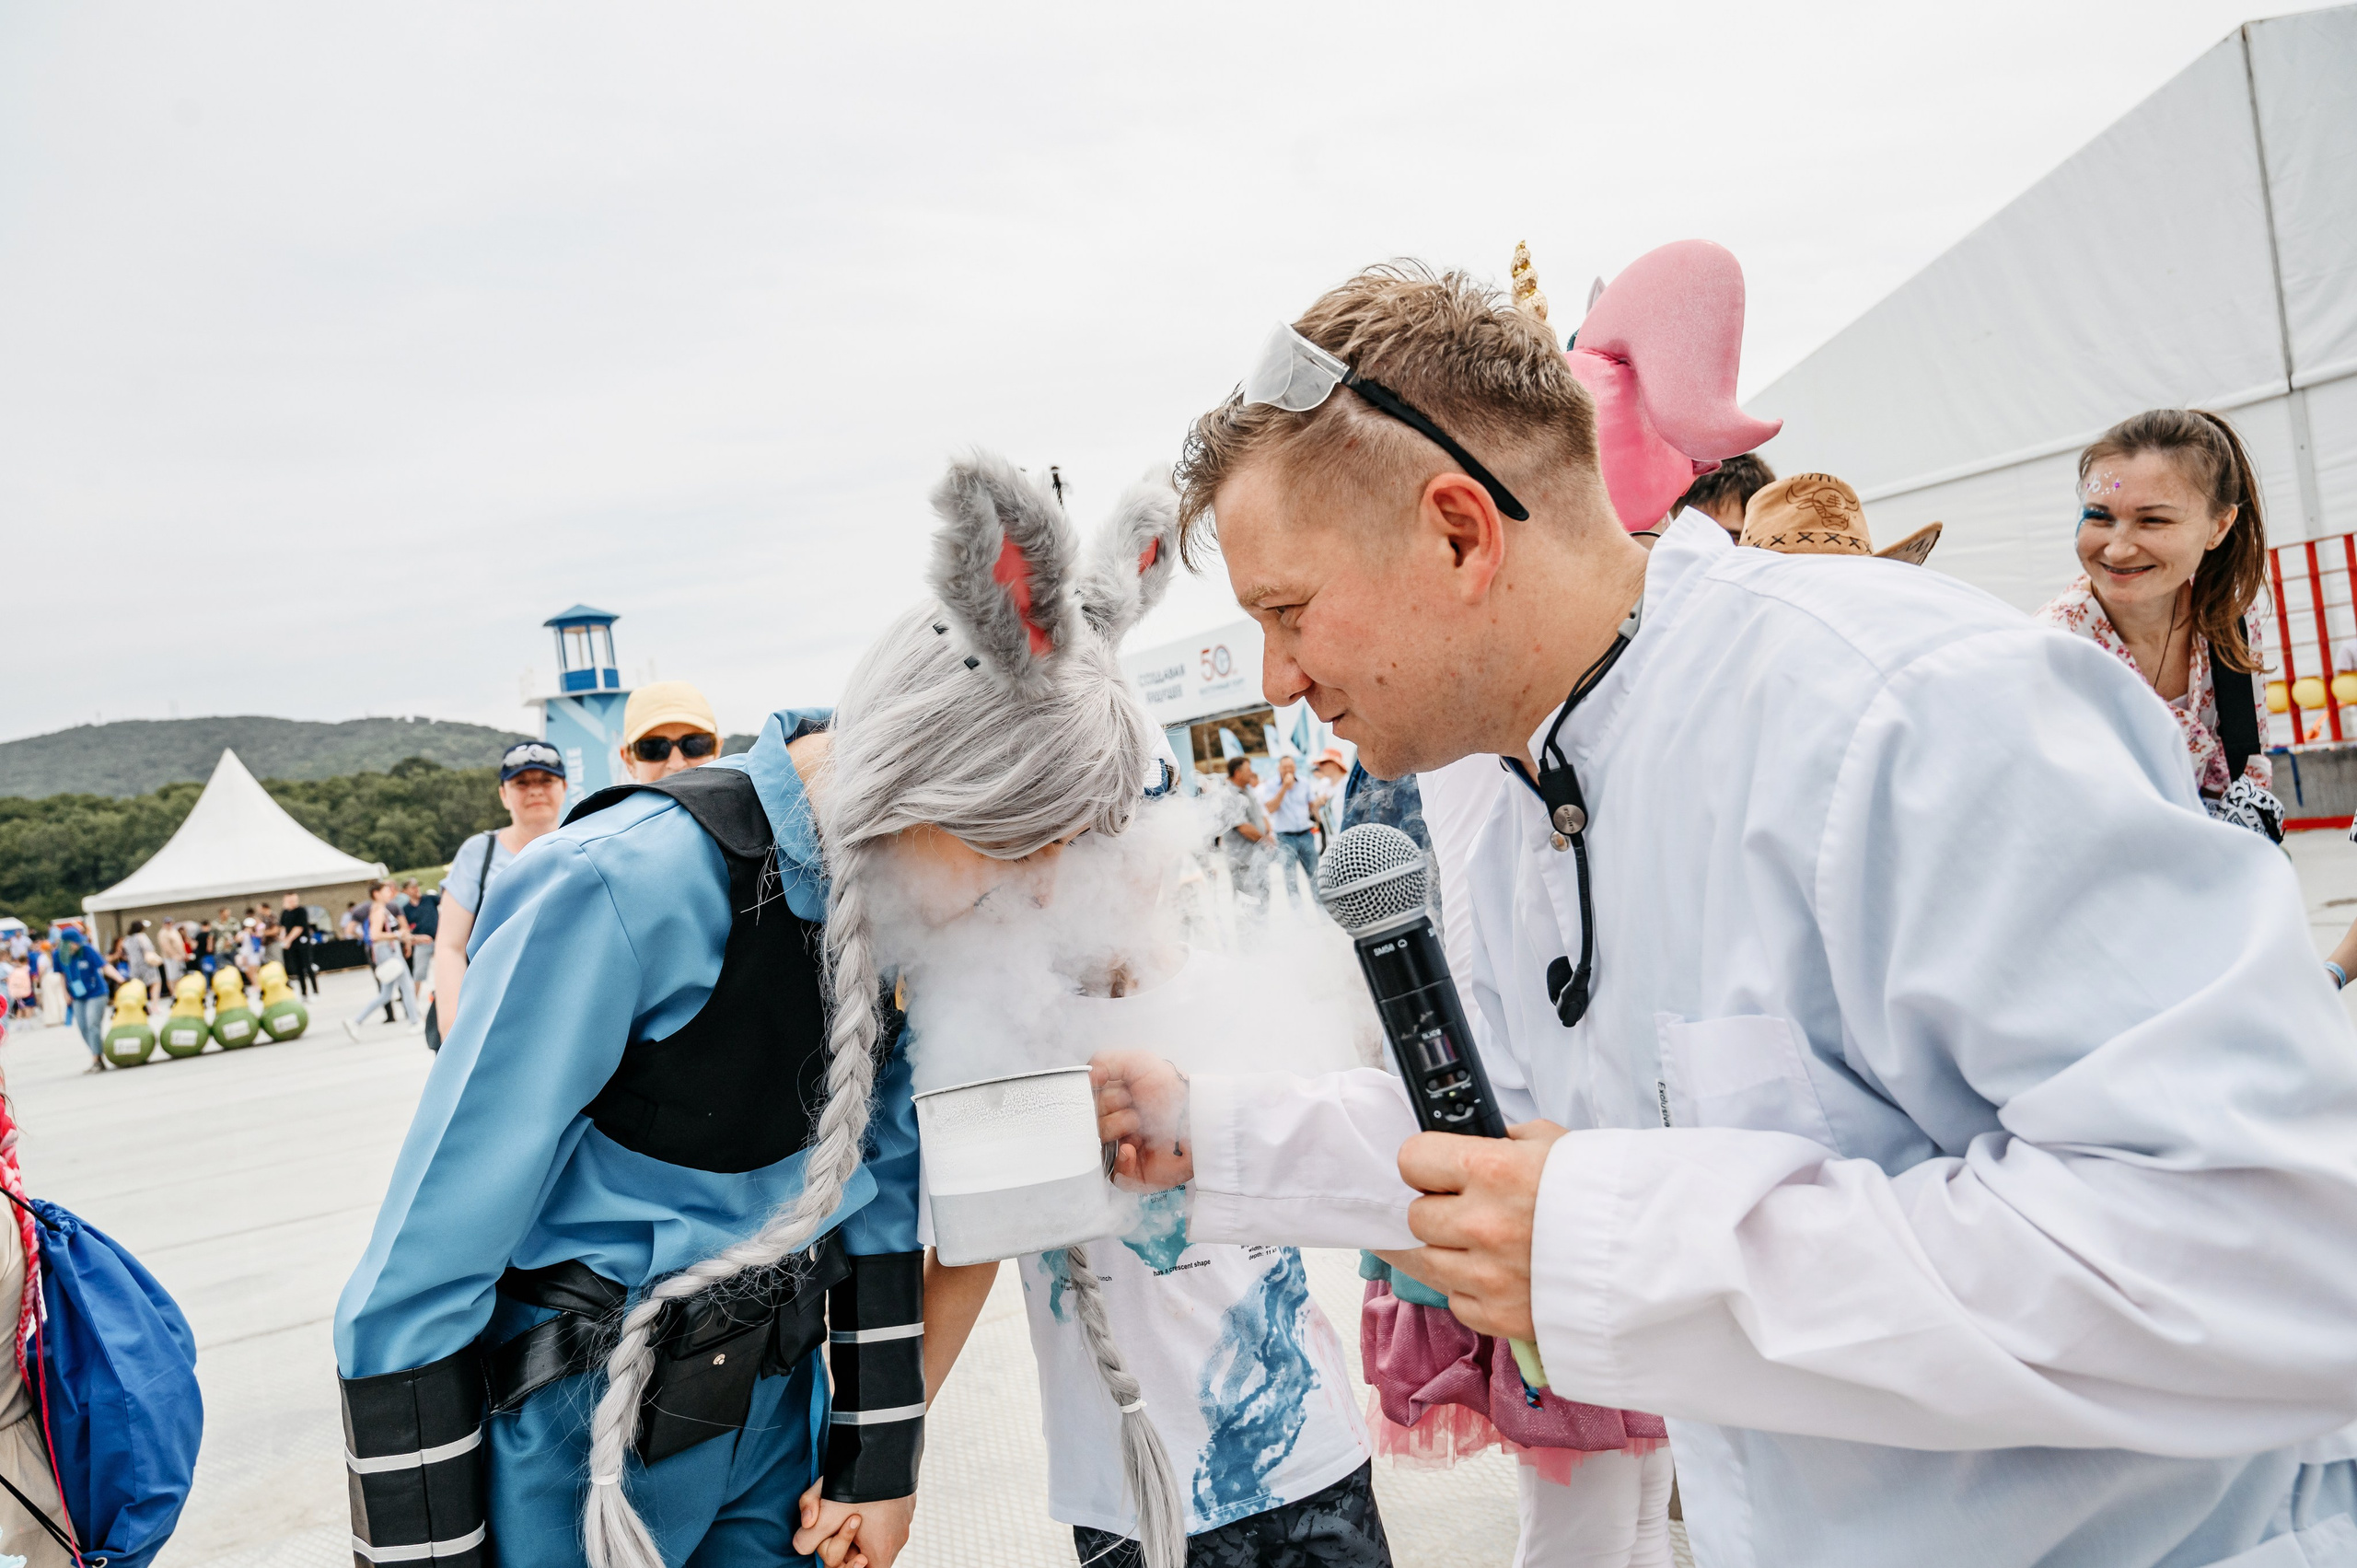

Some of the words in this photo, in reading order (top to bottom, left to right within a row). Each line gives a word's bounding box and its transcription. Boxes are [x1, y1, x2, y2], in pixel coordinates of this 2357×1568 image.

[1657, 1081, 1671, 1128] Exclusive
[1153, 1266, 1164, 1276] has
[1168, 1262, 1193, 1272] crescent
[1193, 1259, 1211, 1269] shape
